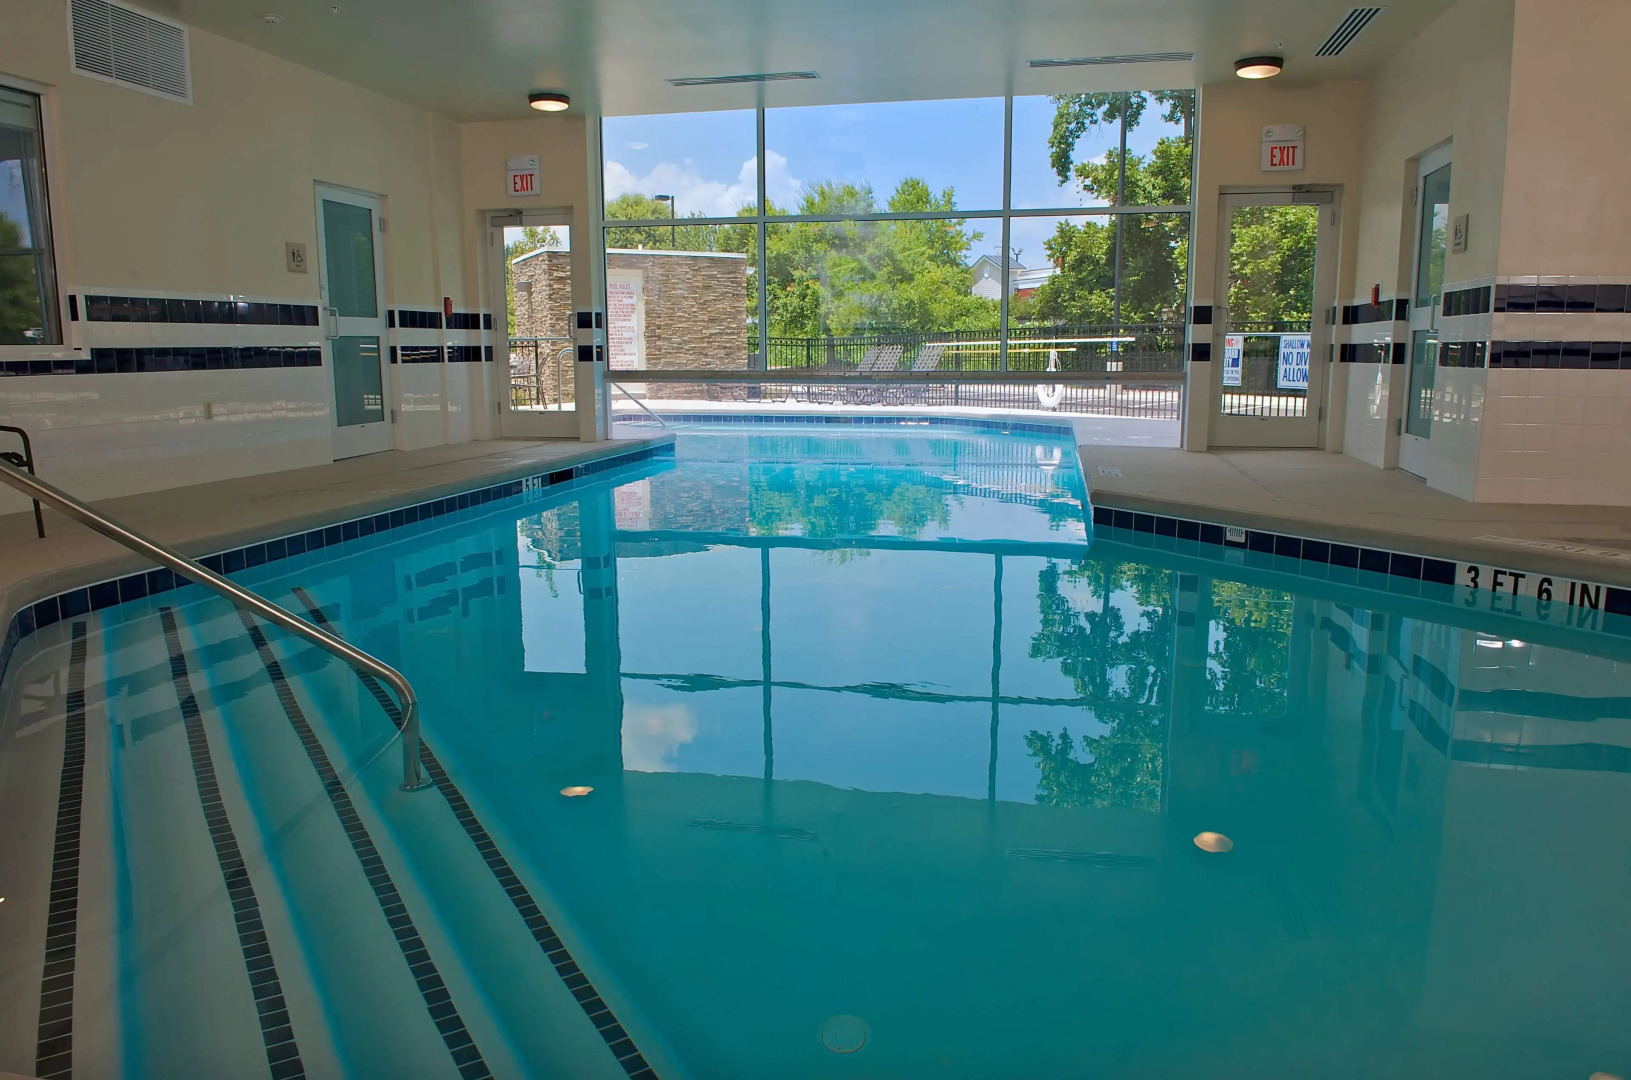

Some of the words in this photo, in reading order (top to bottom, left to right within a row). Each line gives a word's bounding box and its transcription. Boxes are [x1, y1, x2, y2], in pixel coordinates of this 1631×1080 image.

[1270, 146, 1297, 166] EXIT
[513, 174, 534, 192] EXIT
[1283, 340, 1305, 349] SHALLOW
[1282, 351, 1293, 366] NO
[1464, 565, 1480, 589] 3
[1491, 569, 1526, 596] FT
[1537, 577, 1553, 602] 6
[1568, 581, 1601, 610] IN
